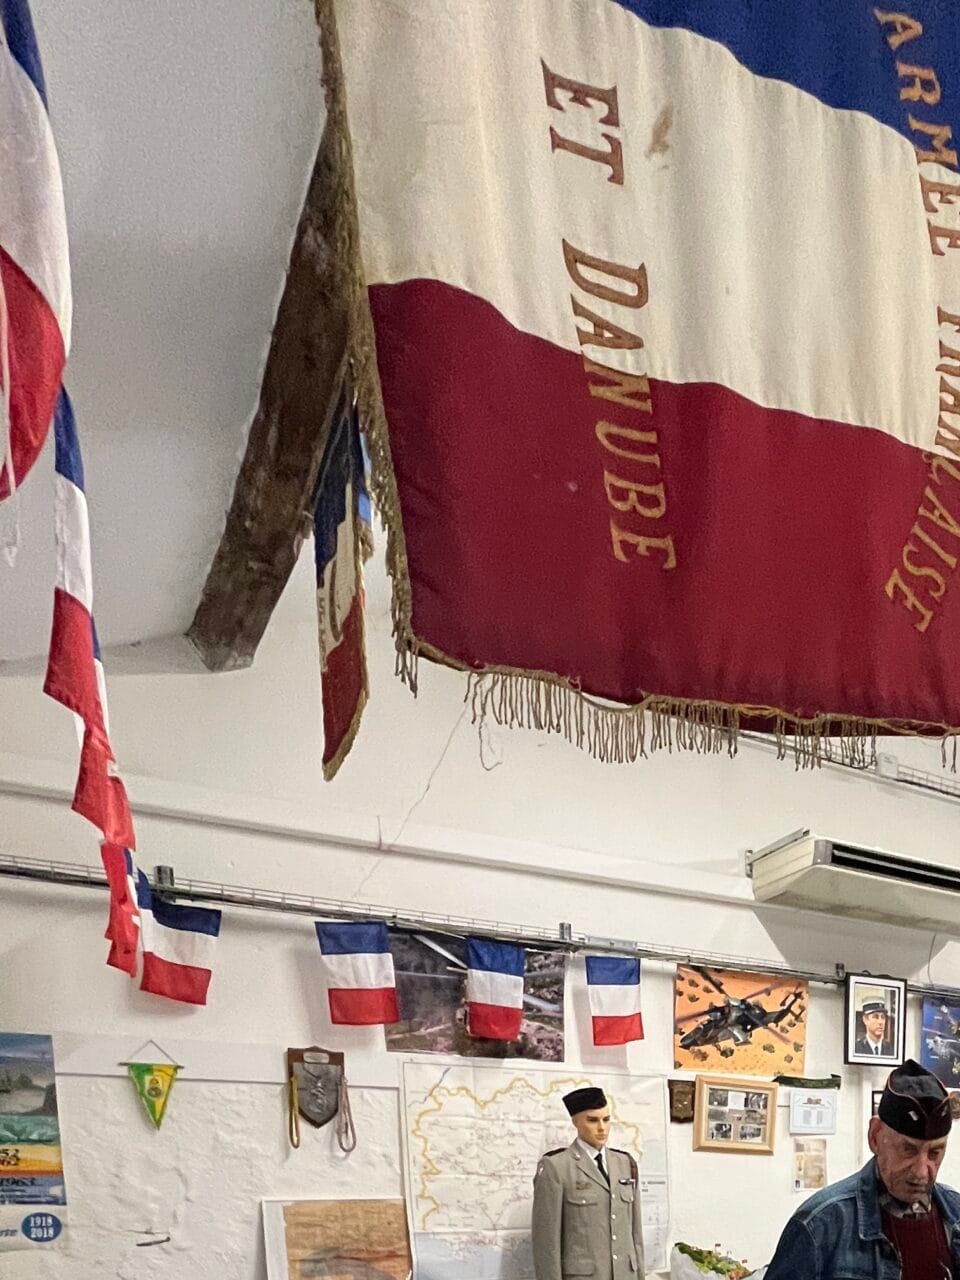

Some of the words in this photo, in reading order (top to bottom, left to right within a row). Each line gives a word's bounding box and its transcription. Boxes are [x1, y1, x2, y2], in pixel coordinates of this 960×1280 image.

[540, 58, 626, 185] ET
[562, 237, 676, 574] DANUBE
[30, 1216, 53, 1227] 1918
[30, 1227, 54, 1238] 2018
